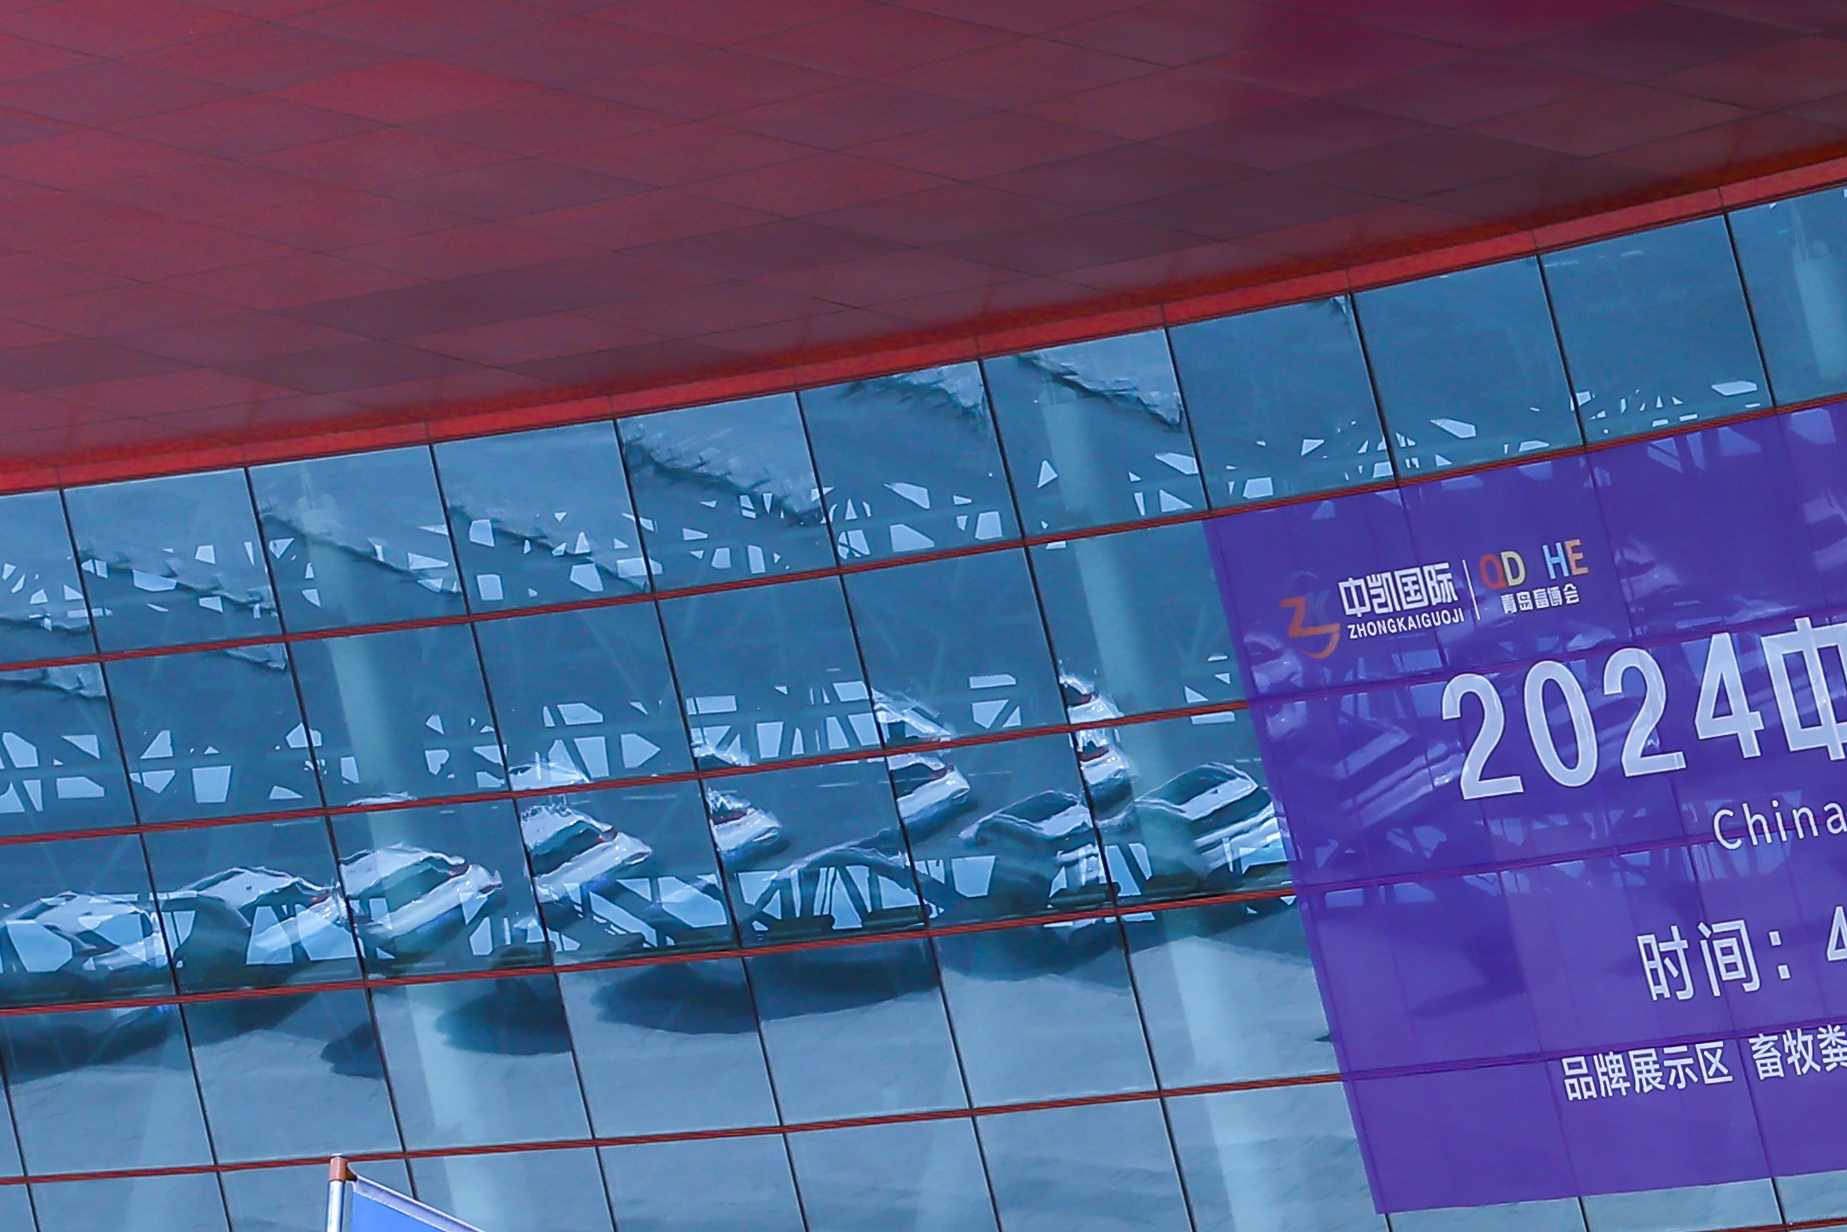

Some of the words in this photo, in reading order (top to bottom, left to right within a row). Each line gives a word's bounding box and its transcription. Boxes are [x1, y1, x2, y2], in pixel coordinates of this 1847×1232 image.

[1337, 561, 1458, 618] 中凯国际
[1347, 607, 1465, 639] ZHONGKAIGUOJI
[1712, 800, 1847, 851] China
[1561, 1040, 1733, 1101] 品牌展示区
